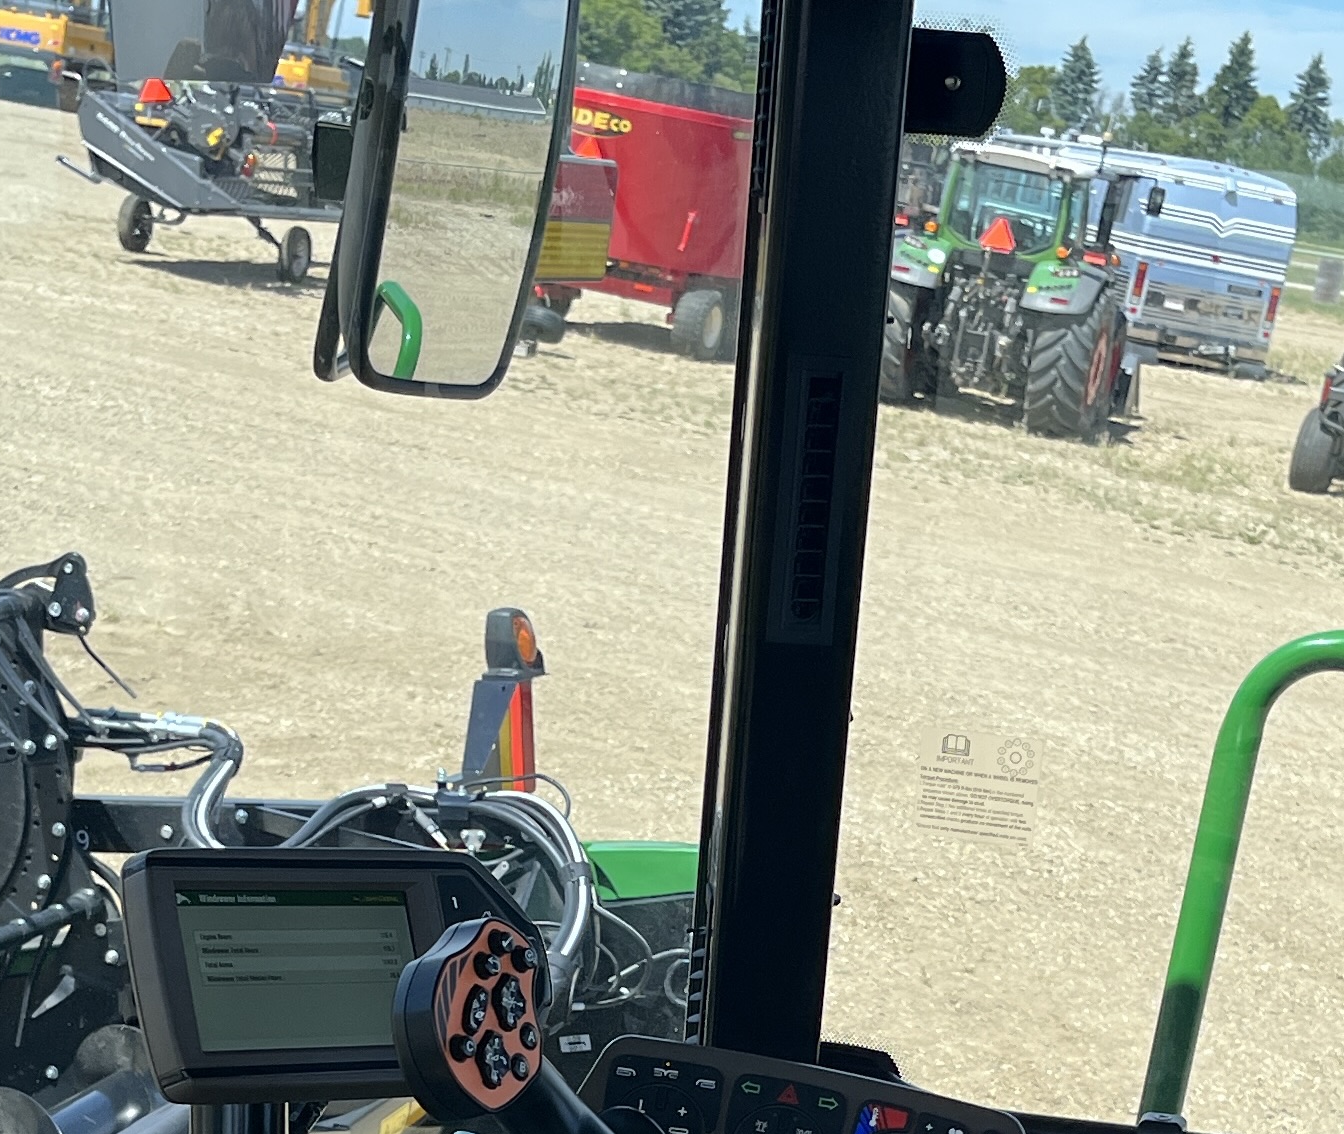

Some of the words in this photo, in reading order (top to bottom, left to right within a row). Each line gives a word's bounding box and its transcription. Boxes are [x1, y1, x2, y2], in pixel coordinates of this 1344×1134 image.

[0, 27, 41, 45] XCMG
[937, 755, 974, 765] IMPORTANT
[76, 829, 90, 851] 9
[527, 1030, 536, 1043] A
[466, 1040, 475, 1052] C
[519, 1060, 527, 1073] B
